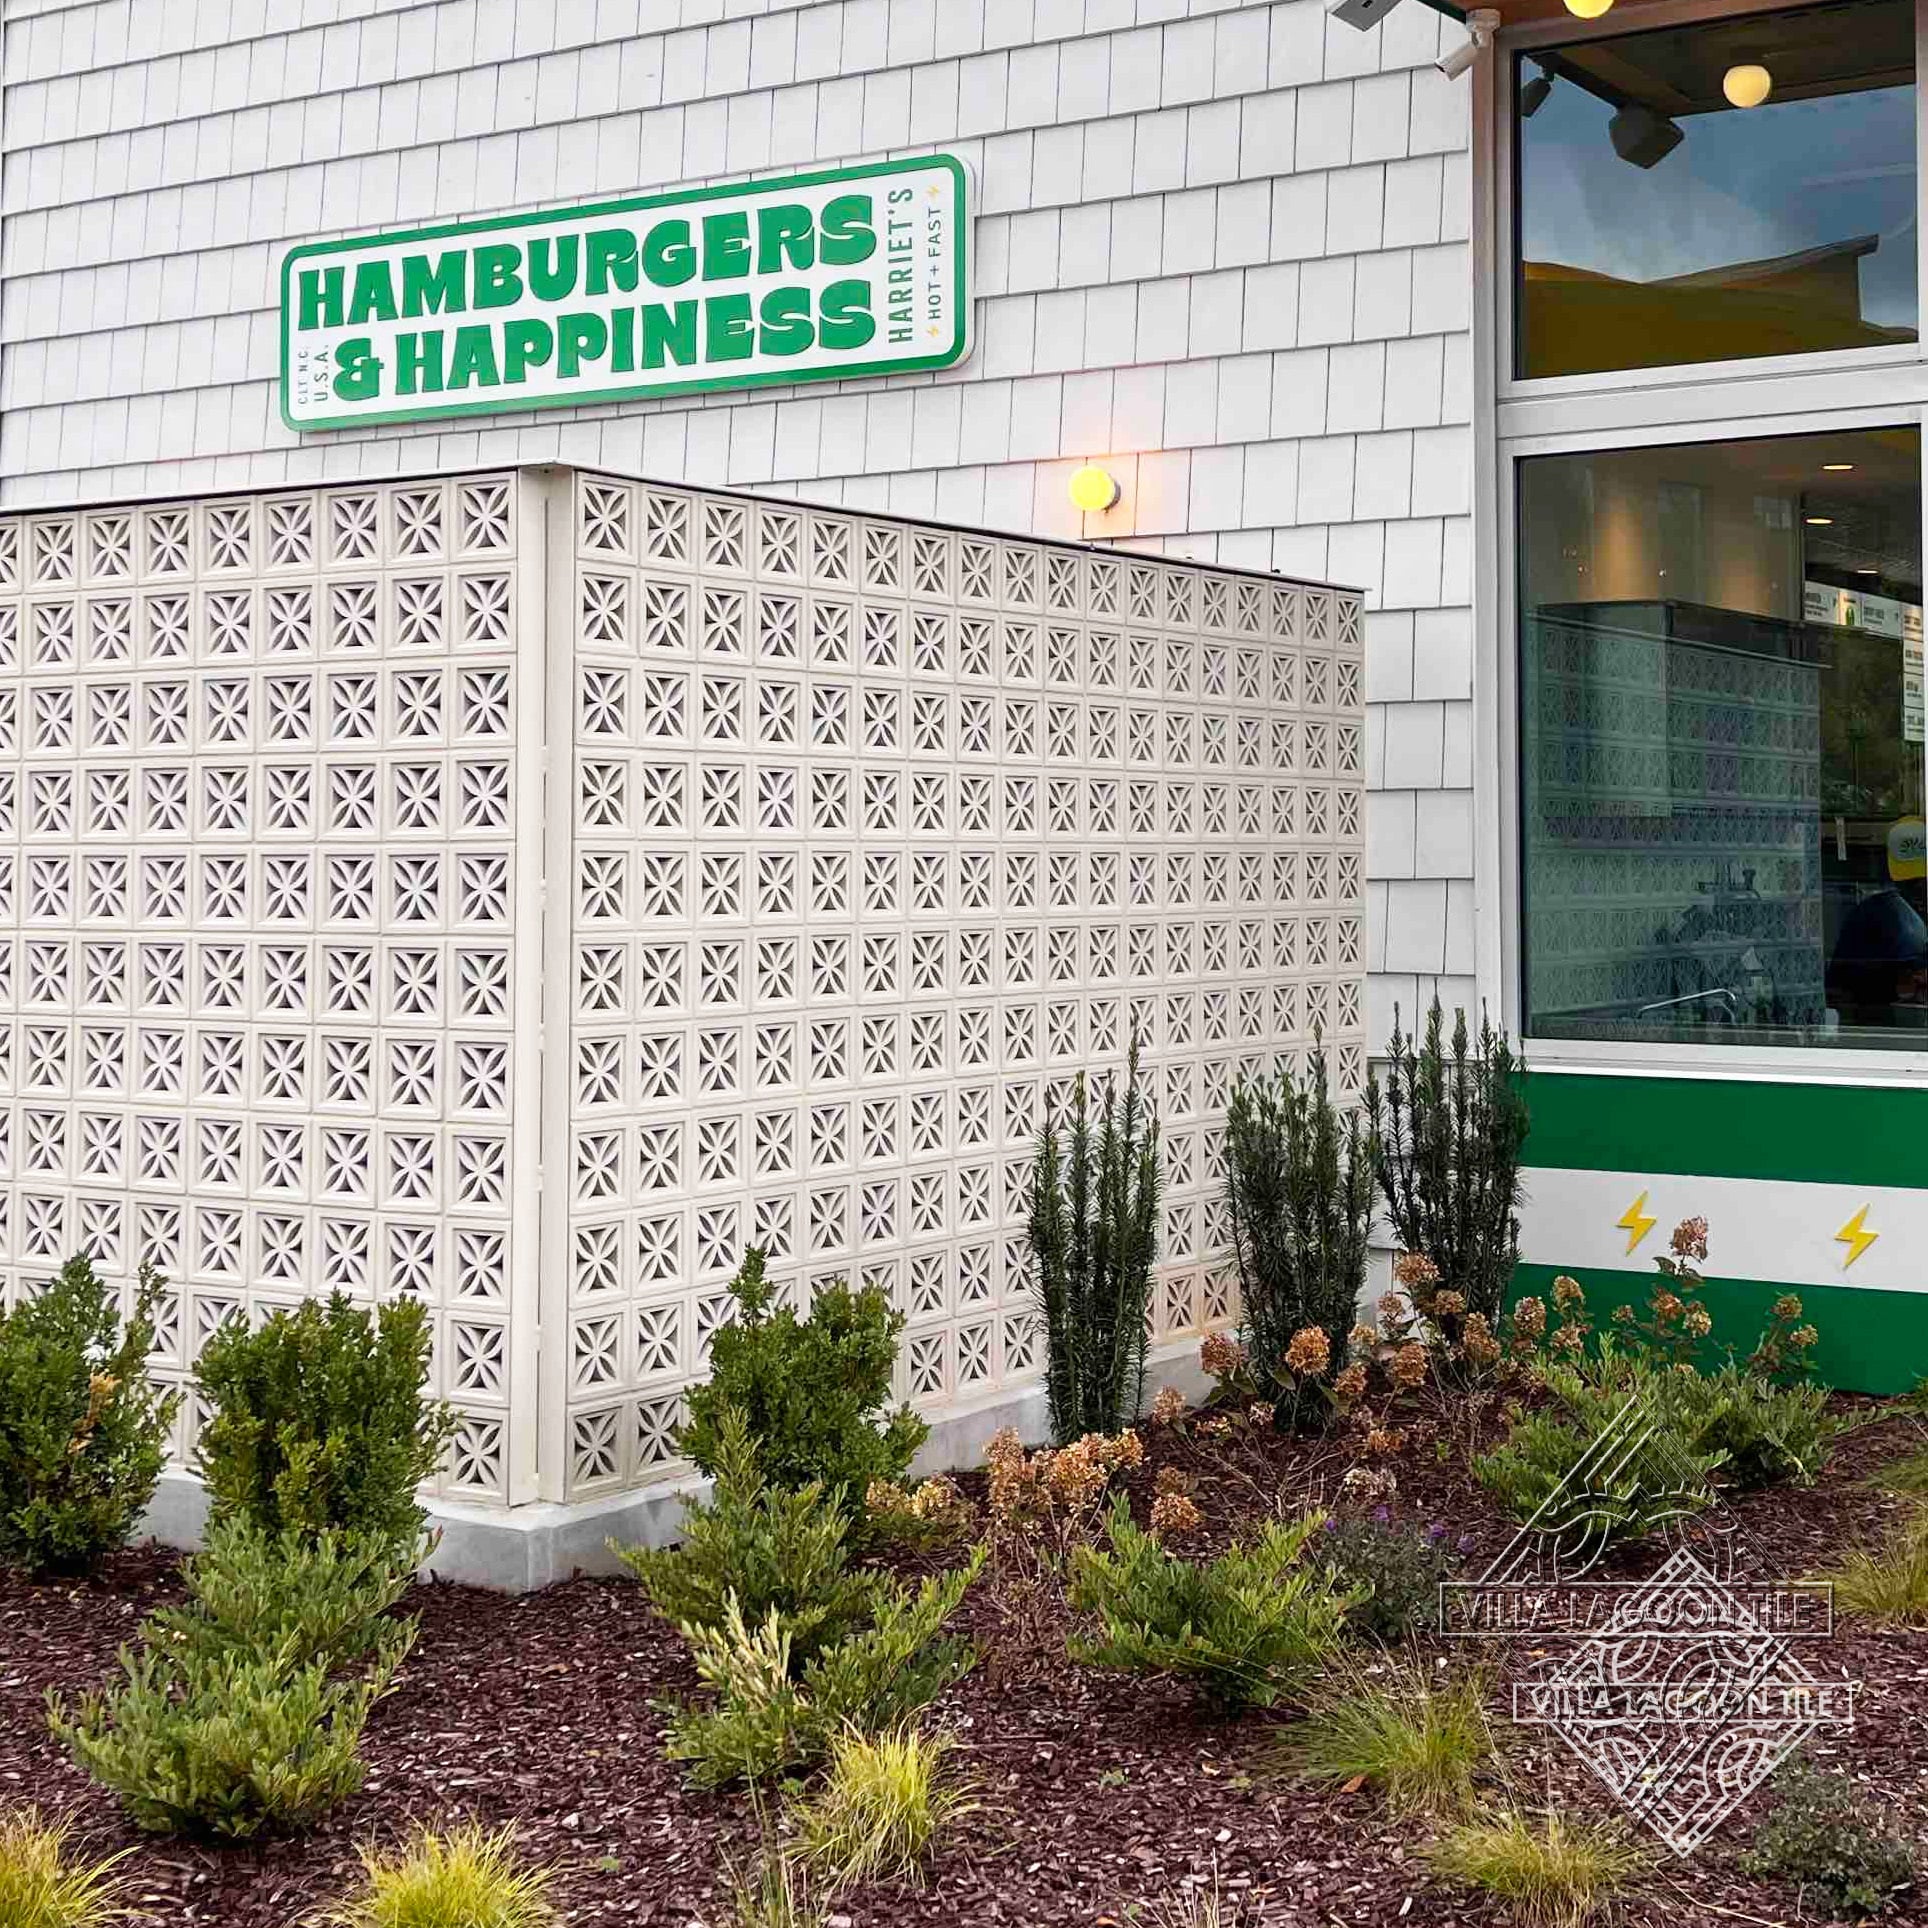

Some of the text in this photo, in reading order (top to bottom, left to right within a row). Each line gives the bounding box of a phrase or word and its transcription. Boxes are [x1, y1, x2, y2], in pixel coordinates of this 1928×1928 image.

[298, 195, 877, 331] HAMBURGERS
[888, 188, 913, 343] HARRIET'S
[928, 207, 941, 257] FAST
[333, 279, 876, 401] & HAPPINESS
[928, 282, 941, 319] HOT
[314, 344, 328, 401] U.S.A.
